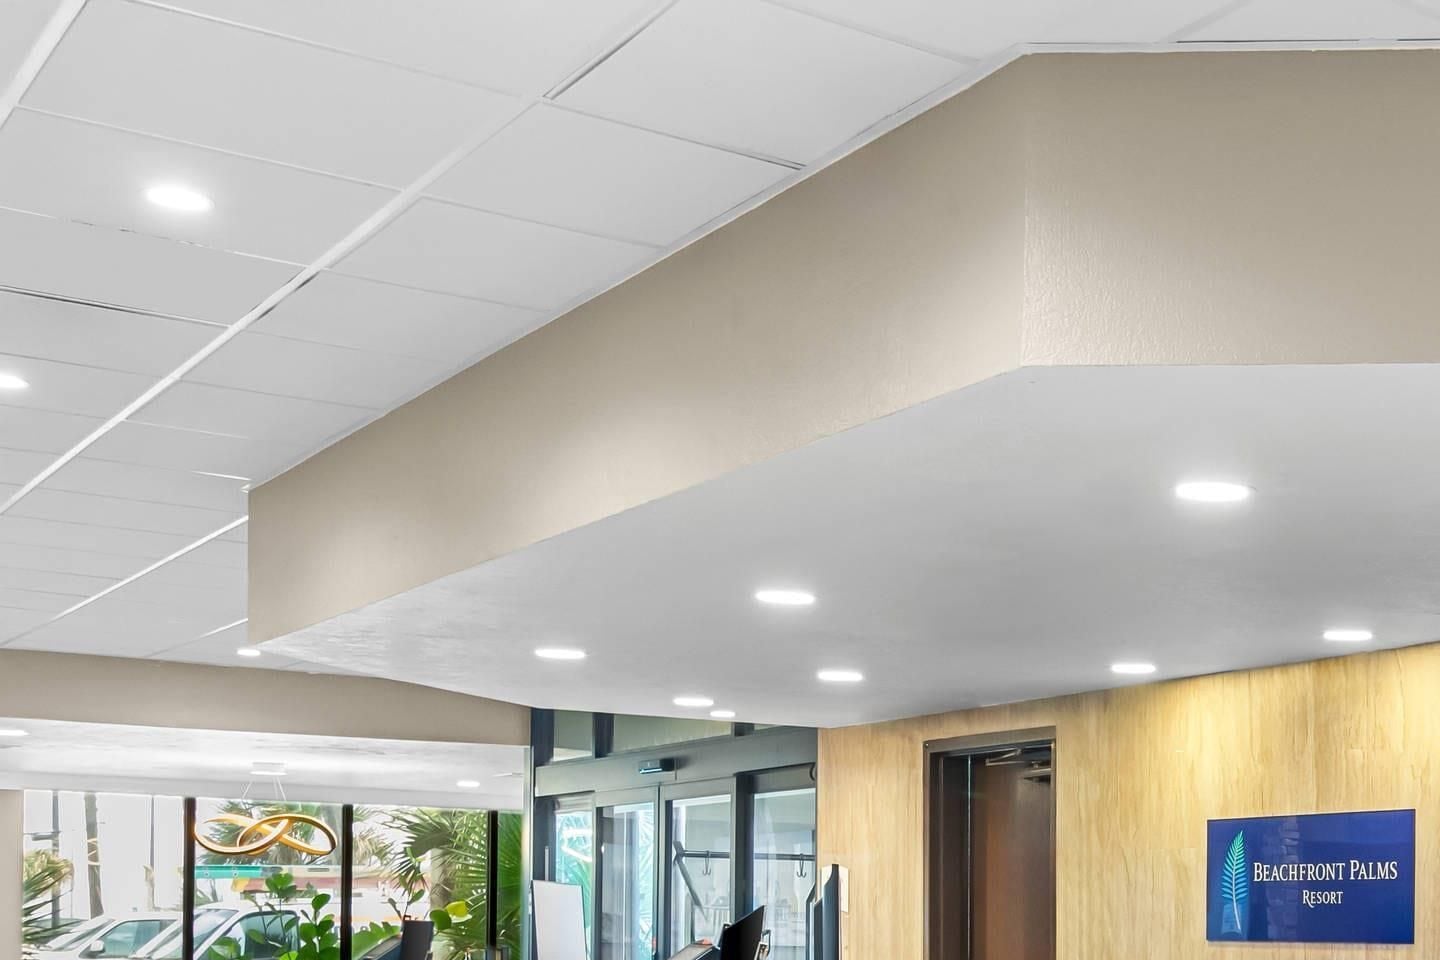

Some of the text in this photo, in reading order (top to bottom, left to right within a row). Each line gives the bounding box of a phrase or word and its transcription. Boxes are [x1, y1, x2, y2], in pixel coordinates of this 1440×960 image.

[1253, 859, 1398, 882] BEACHFRONT PALMS
[1302, 889, 1344, 909] RESORT
